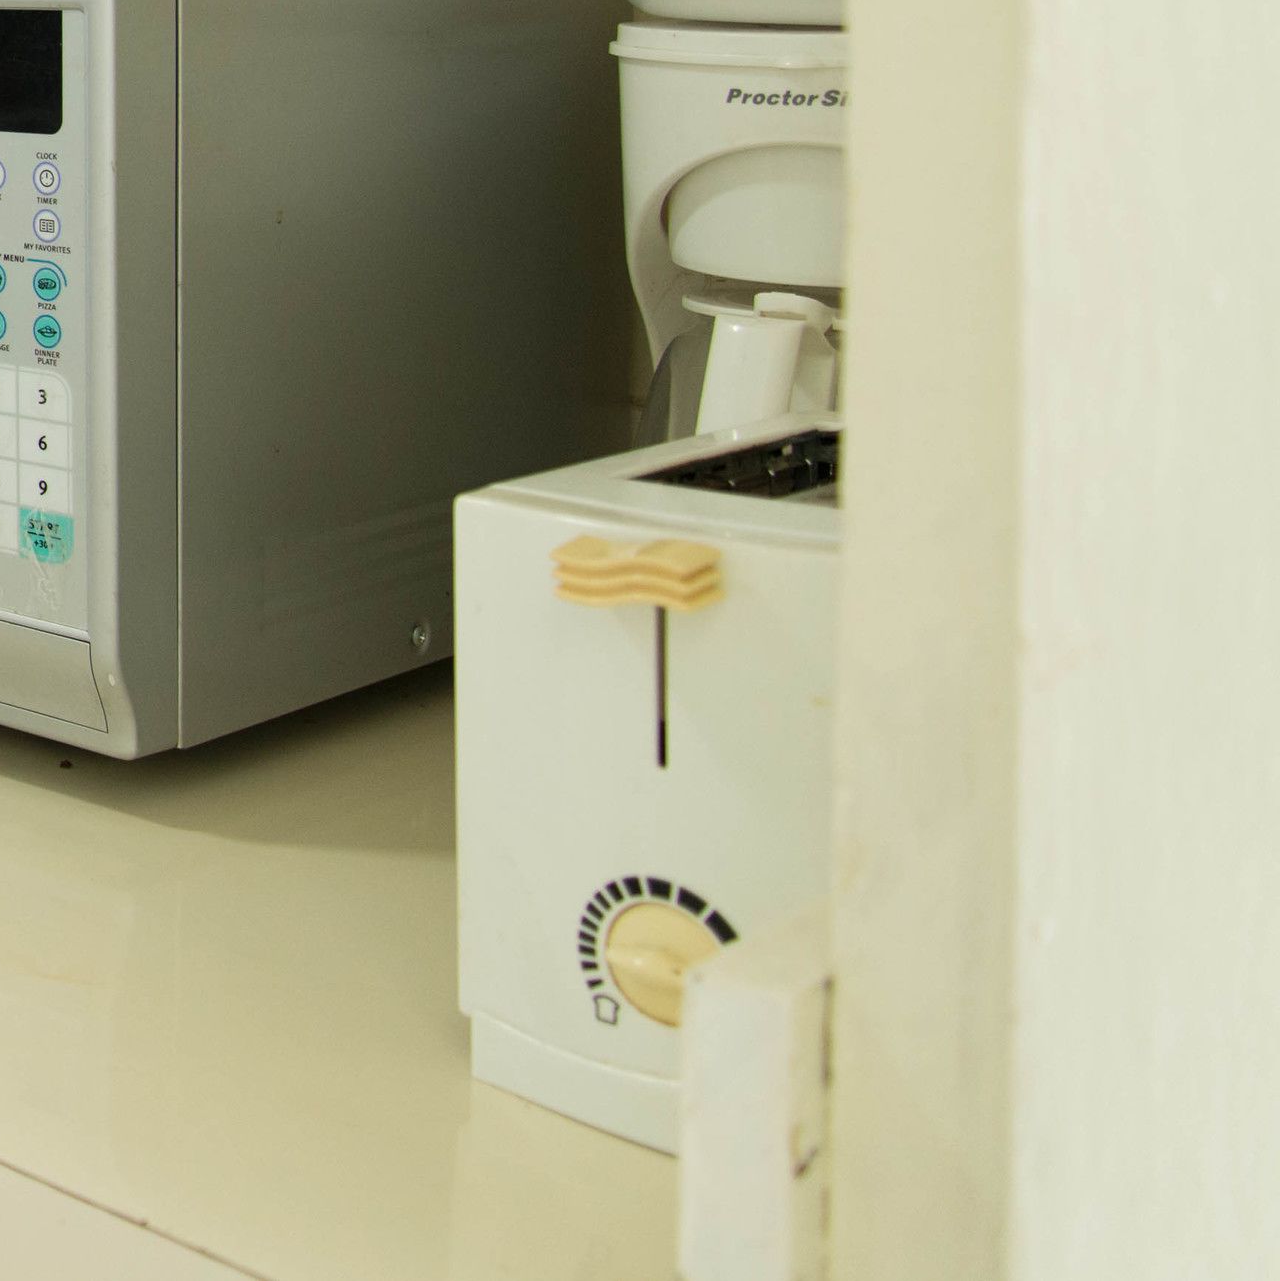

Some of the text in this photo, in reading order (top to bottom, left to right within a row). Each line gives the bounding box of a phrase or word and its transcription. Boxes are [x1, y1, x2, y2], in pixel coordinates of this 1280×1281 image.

[36, 152, 57, 160] CLOCK
[37, 197, 58, 205] TIMER
[23, 243, 71, 254] MY FAVORITES
[3, 254, 25, 263] MENU
[37, 302, 57, 311] PIZZA
[34, 349, 60, 358] DINNER
[37, 358, 58, 367] PLATE
[38, 389, 47, 405] 3
[38, 435, 48, 451] 6
[38, 480, 48, 496] 9
